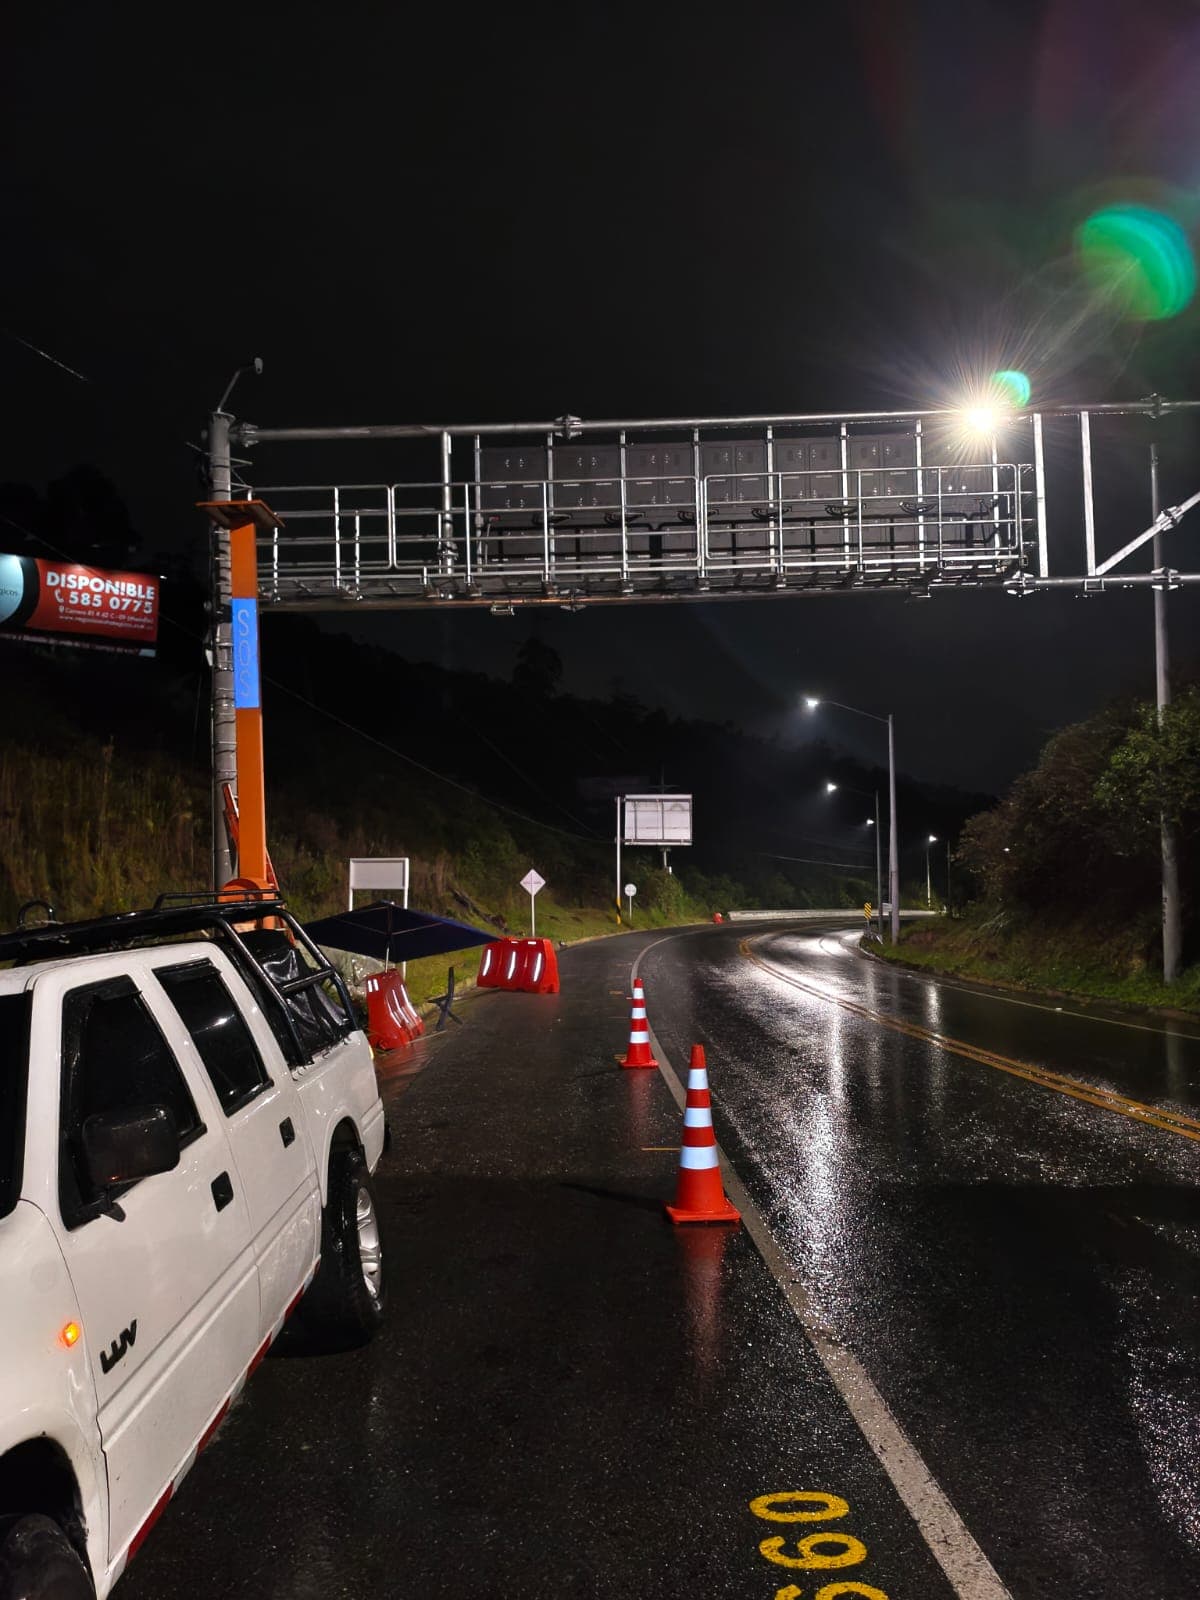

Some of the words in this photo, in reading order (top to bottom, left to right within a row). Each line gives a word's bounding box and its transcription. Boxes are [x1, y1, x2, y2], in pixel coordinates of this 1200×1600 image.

[46, 571, 155, 600] DISPONIBLE
[69, 591, 102, 607] 585
[109, 596, 153, 614] 0775
[237, 609, 251, 697] SOS
[99, 1318, 137, 1375] LUV
